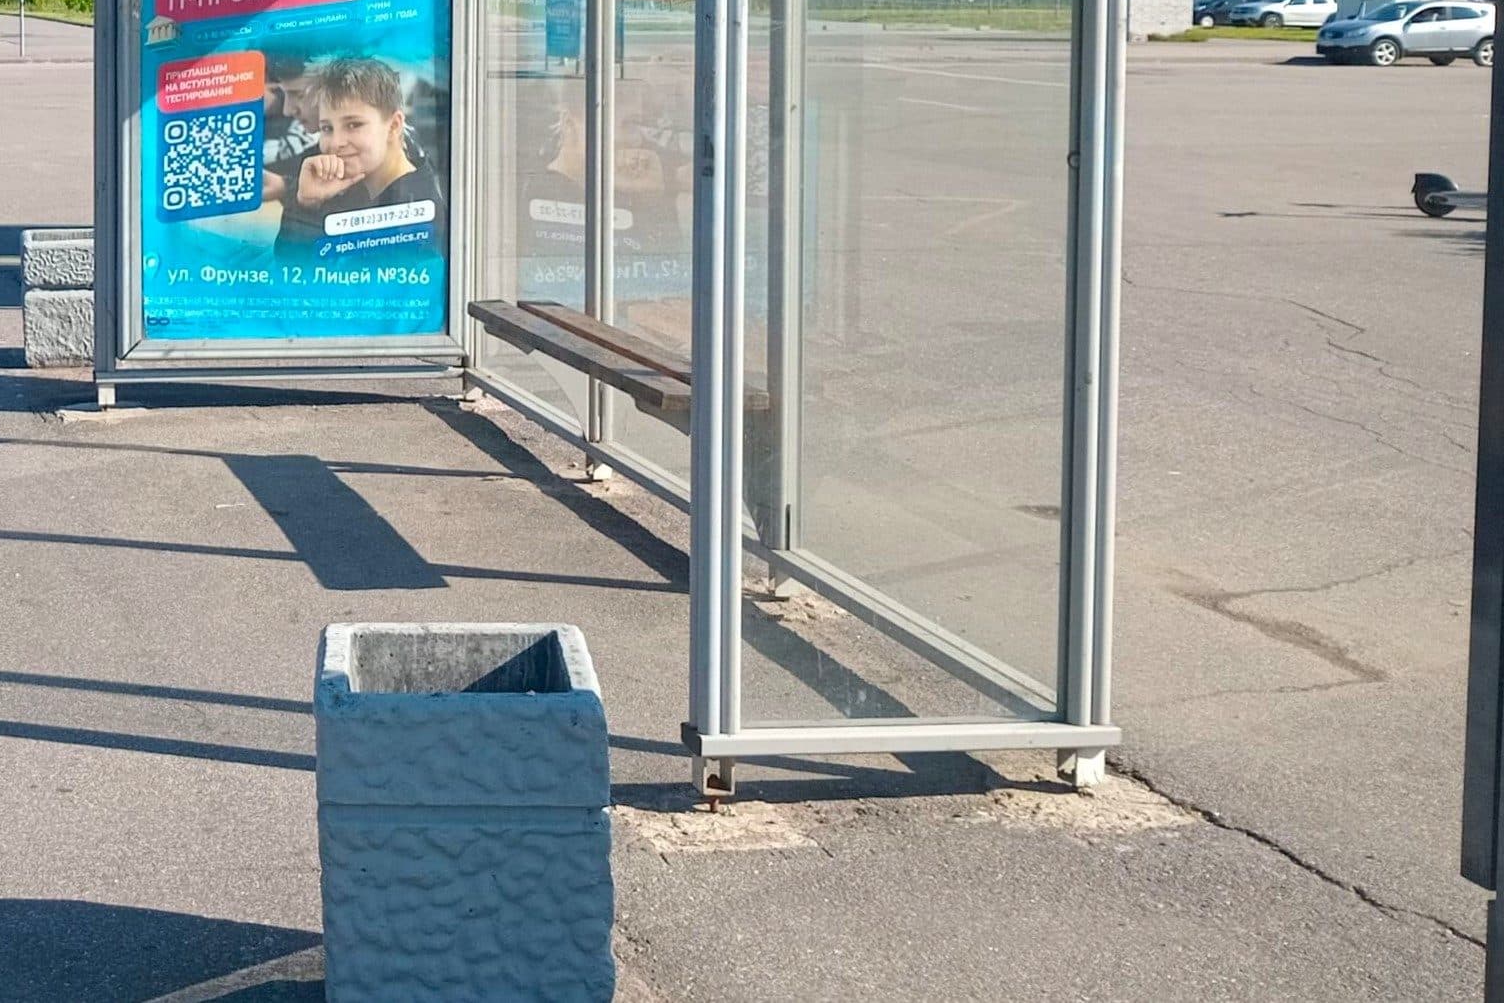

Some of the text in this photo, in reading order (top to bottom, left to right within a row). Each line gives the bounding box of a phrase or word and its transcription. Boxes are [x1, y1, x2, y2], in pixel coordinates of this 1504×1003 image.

[165, 64, 228, 81] ПРИГЛАШАЕМ
[165, 72, 255, 93] НА ВСТУПИТЕЛЬНОЕ
[165, 86, 234, 104] ТЕСТИРОВАНИЕ
[336, 218, 348, 228] +7
[350, 213, 376, 228] (812)
[335, 231, 429, 254] spb.informatics.ru
[168, 265, 431, 286] ул. Фрунзе, 12, Лицей №366
